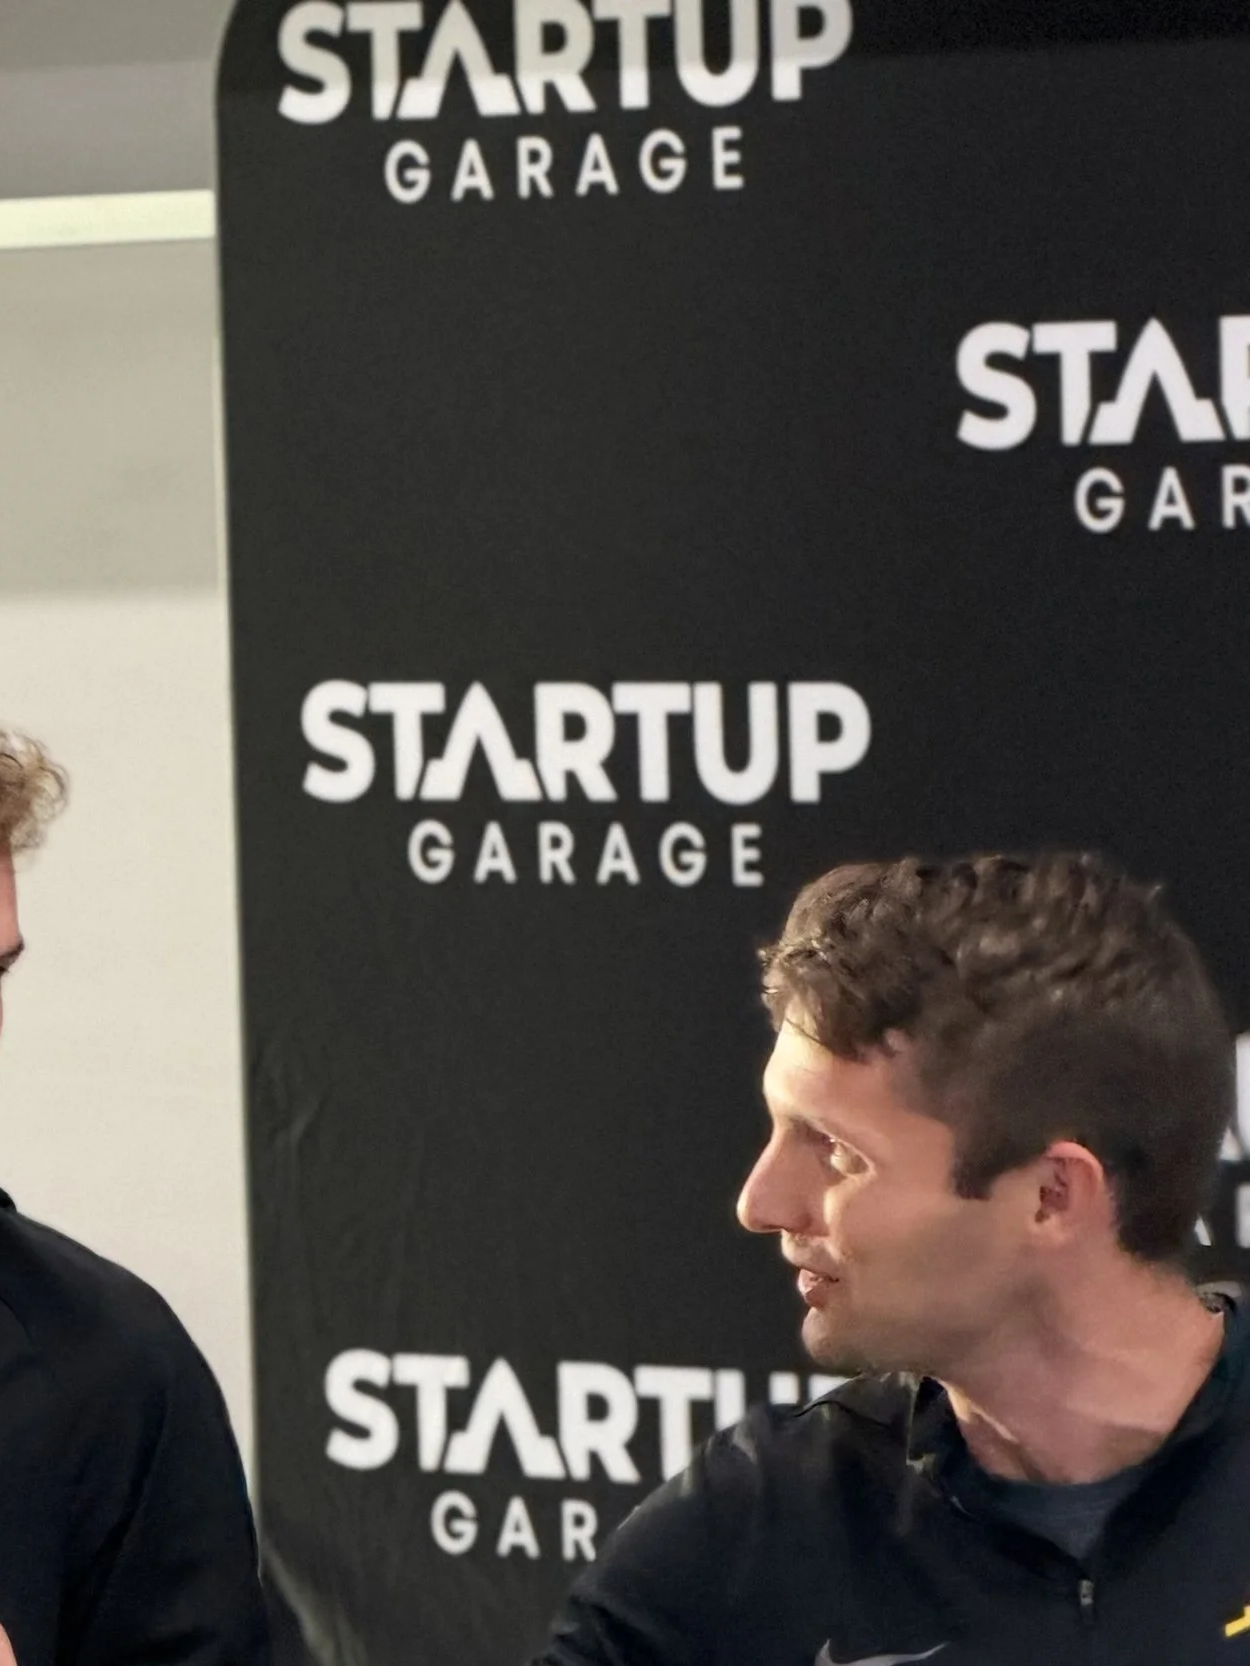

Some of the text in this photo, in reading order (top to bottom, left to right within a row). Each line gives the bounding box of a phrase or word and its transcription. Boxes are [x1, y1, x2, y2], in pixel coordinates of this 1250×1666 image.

[278, 0, 853, 125] STARTUP
[384, 125, 745, 204] GARAGE
[300, 679, 872, 805] STARTUP
[407, 819, 764, 888] GARAGE
[324, 1348, 851, 1484] START
[430, 1490, 599, 1562] GAR
